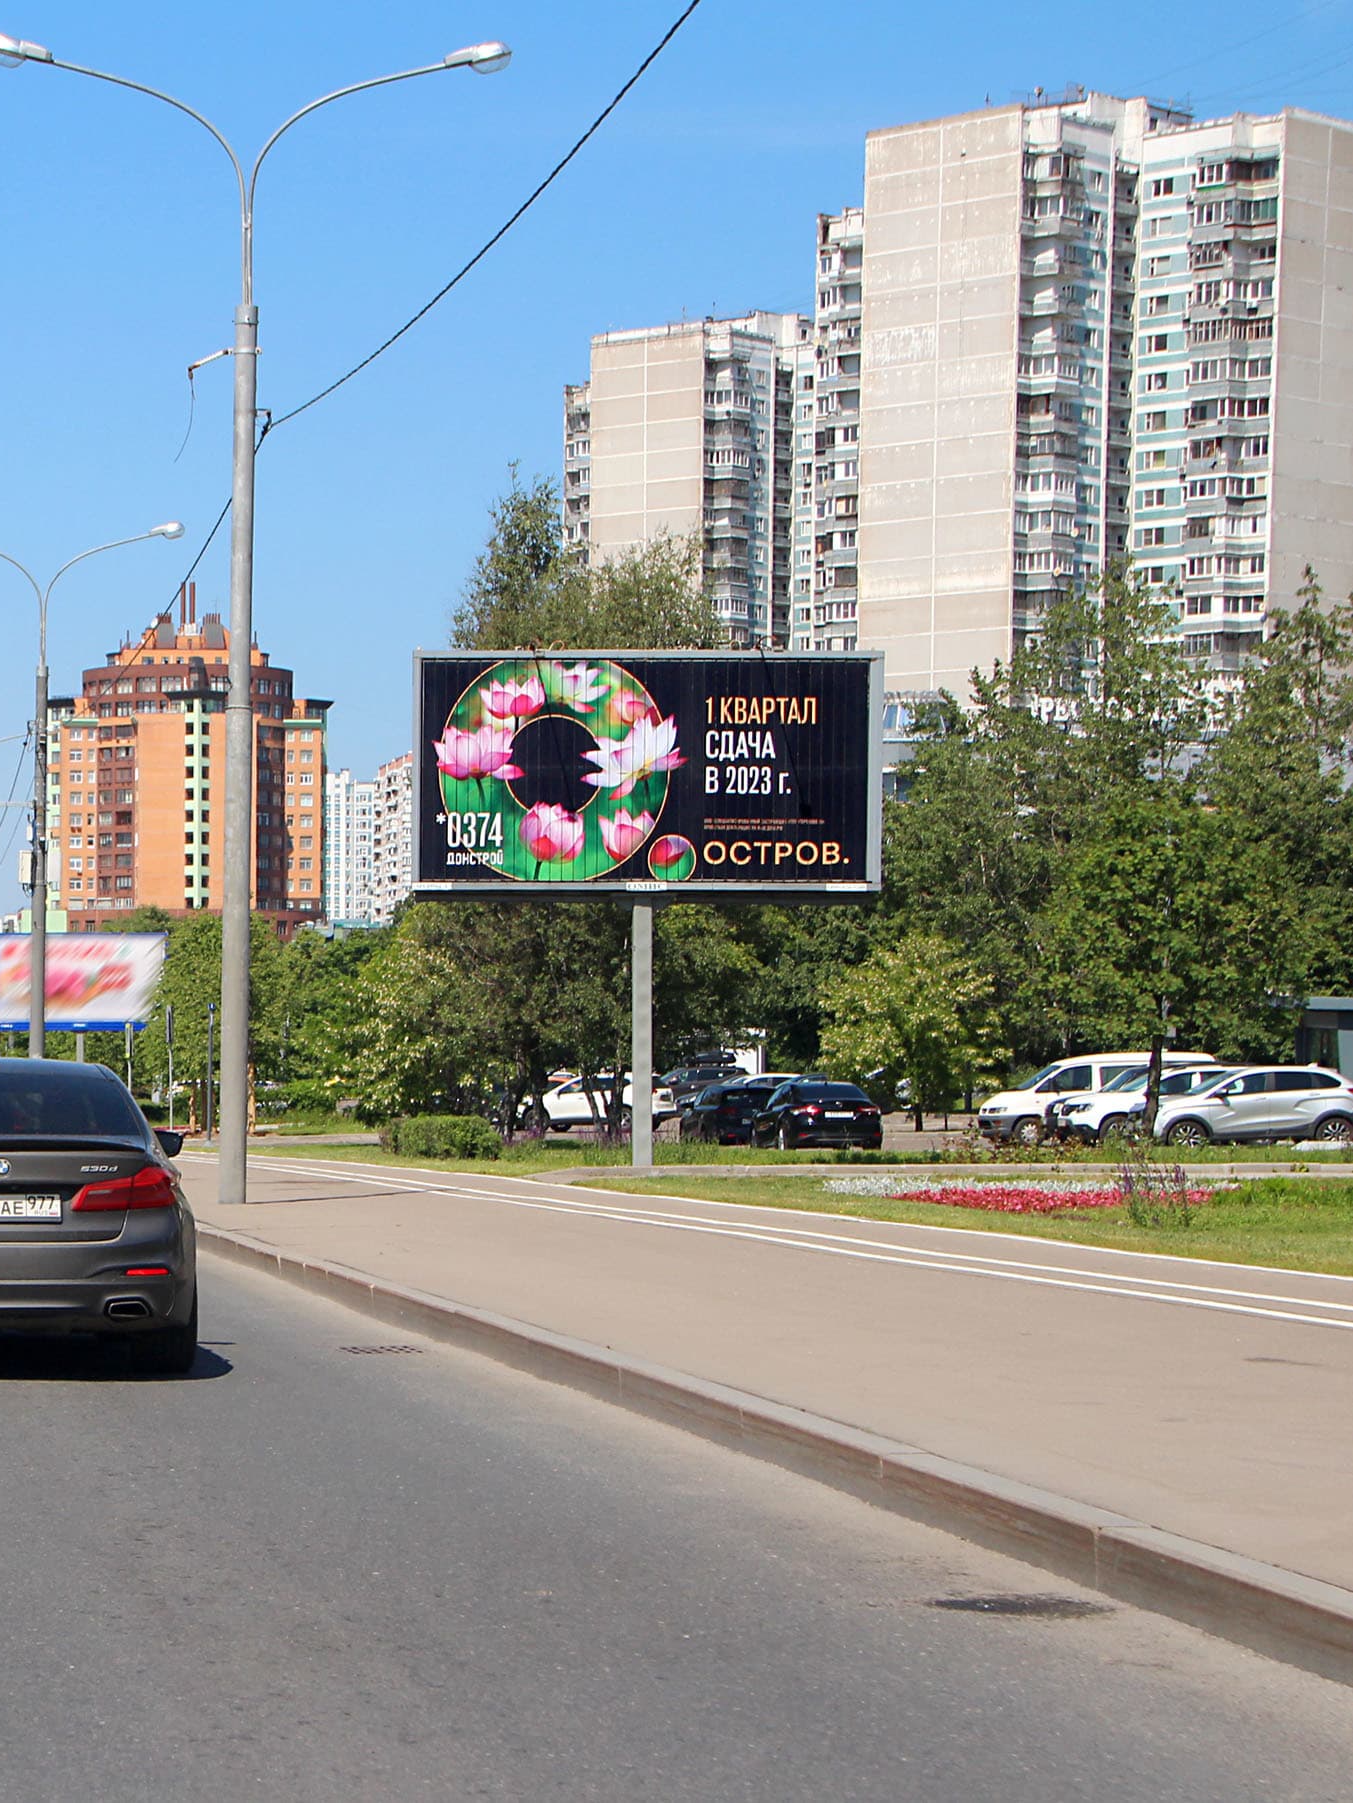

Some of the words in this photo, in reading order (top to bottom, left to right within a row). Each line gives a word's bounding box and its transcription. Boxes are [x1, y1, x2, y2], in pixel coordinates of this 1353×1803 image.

[705, 696, 713, 725] 1
[720, 696, 817, 725] КВАРТАЛ
[705, 730, 776, 762] СДАЧА
[704, 765, 719, 795] В
[725, 765, 772, 795] 2023
[778, 772, 792, 795] г.
[446, 848, 503, 866] ДОНСТРОЙ
[703, 840, 850, 866] ОСТРОВ.
[28, 1195, 55, 1210] 977
